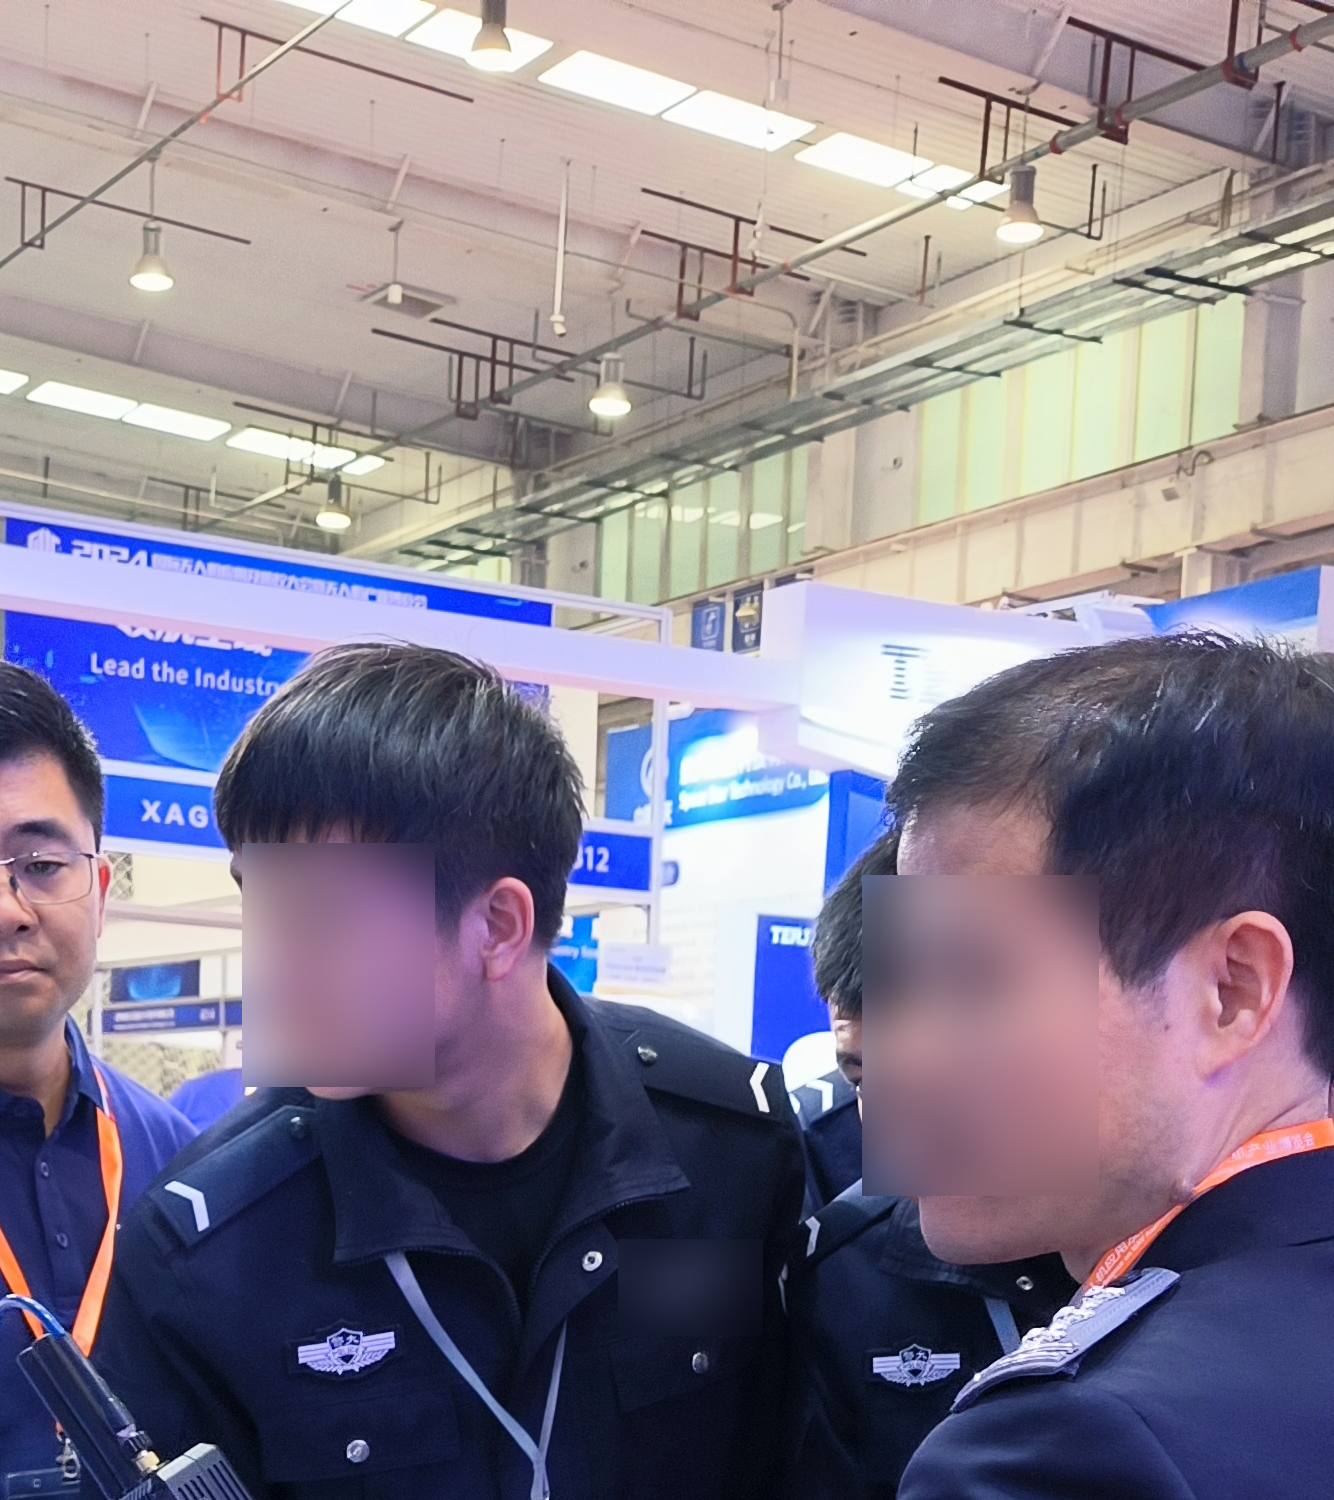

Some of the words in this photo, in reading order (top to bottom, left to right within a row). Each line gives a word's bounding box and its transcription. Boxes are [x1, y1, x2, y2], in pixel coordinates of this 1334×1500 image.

[90, 652, 145, 680] Lead
[151, 662, 189, 686] the
[141, 797, 209, 828] XAG
